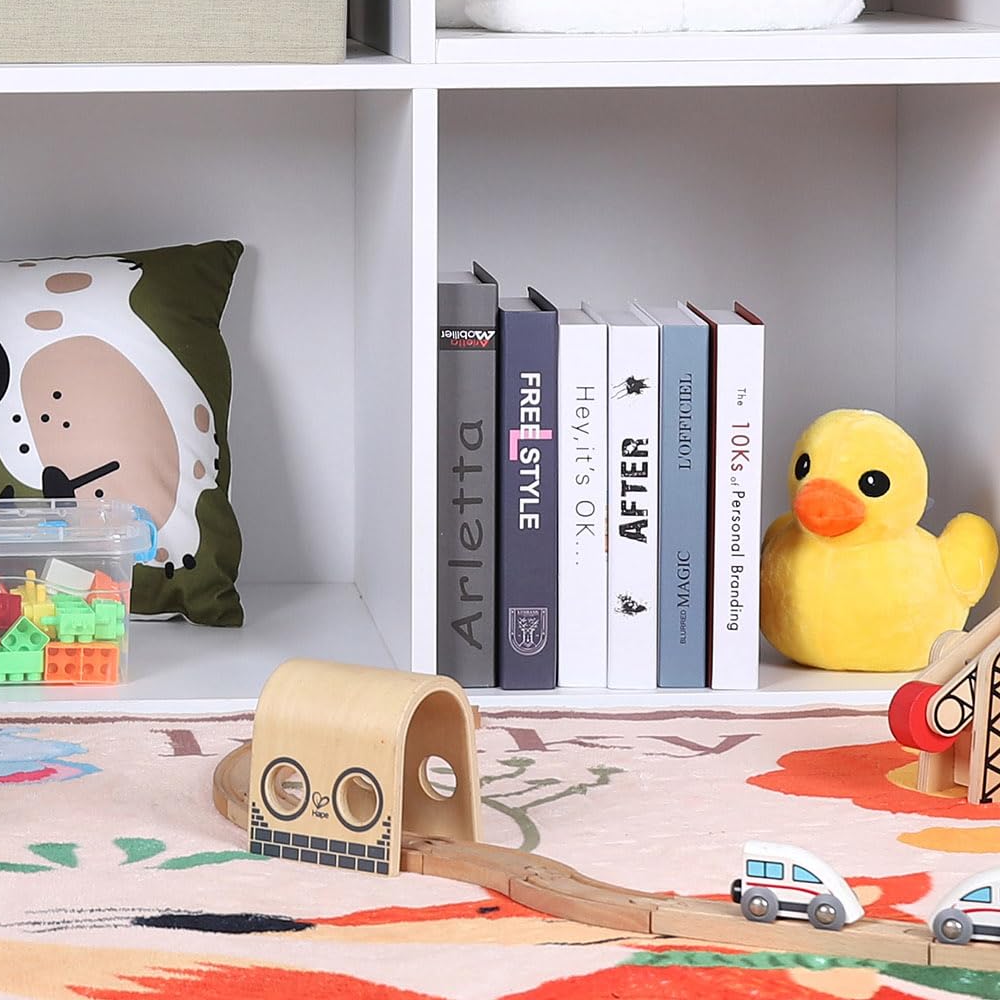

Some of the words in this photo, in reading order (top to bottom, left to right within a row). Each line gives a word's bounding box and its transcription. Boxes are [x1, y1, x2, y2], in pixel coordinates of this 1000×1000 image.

[519, 372, 541, 440] FREE
[678, 373, 693, 470] L'OFFICIEL
[737, 387, 747, 407] The
[518, 446, 541, 530] STYLE
[619, 437, 649, 544] AFTER
[729, 475, 739, 487] of
[448, 419, 484, 651] Arletta
[730, 491, 746, 557] Personal
[675, 550, 691, 608] MAGIC
[726, 565, 744, 632] Branding
